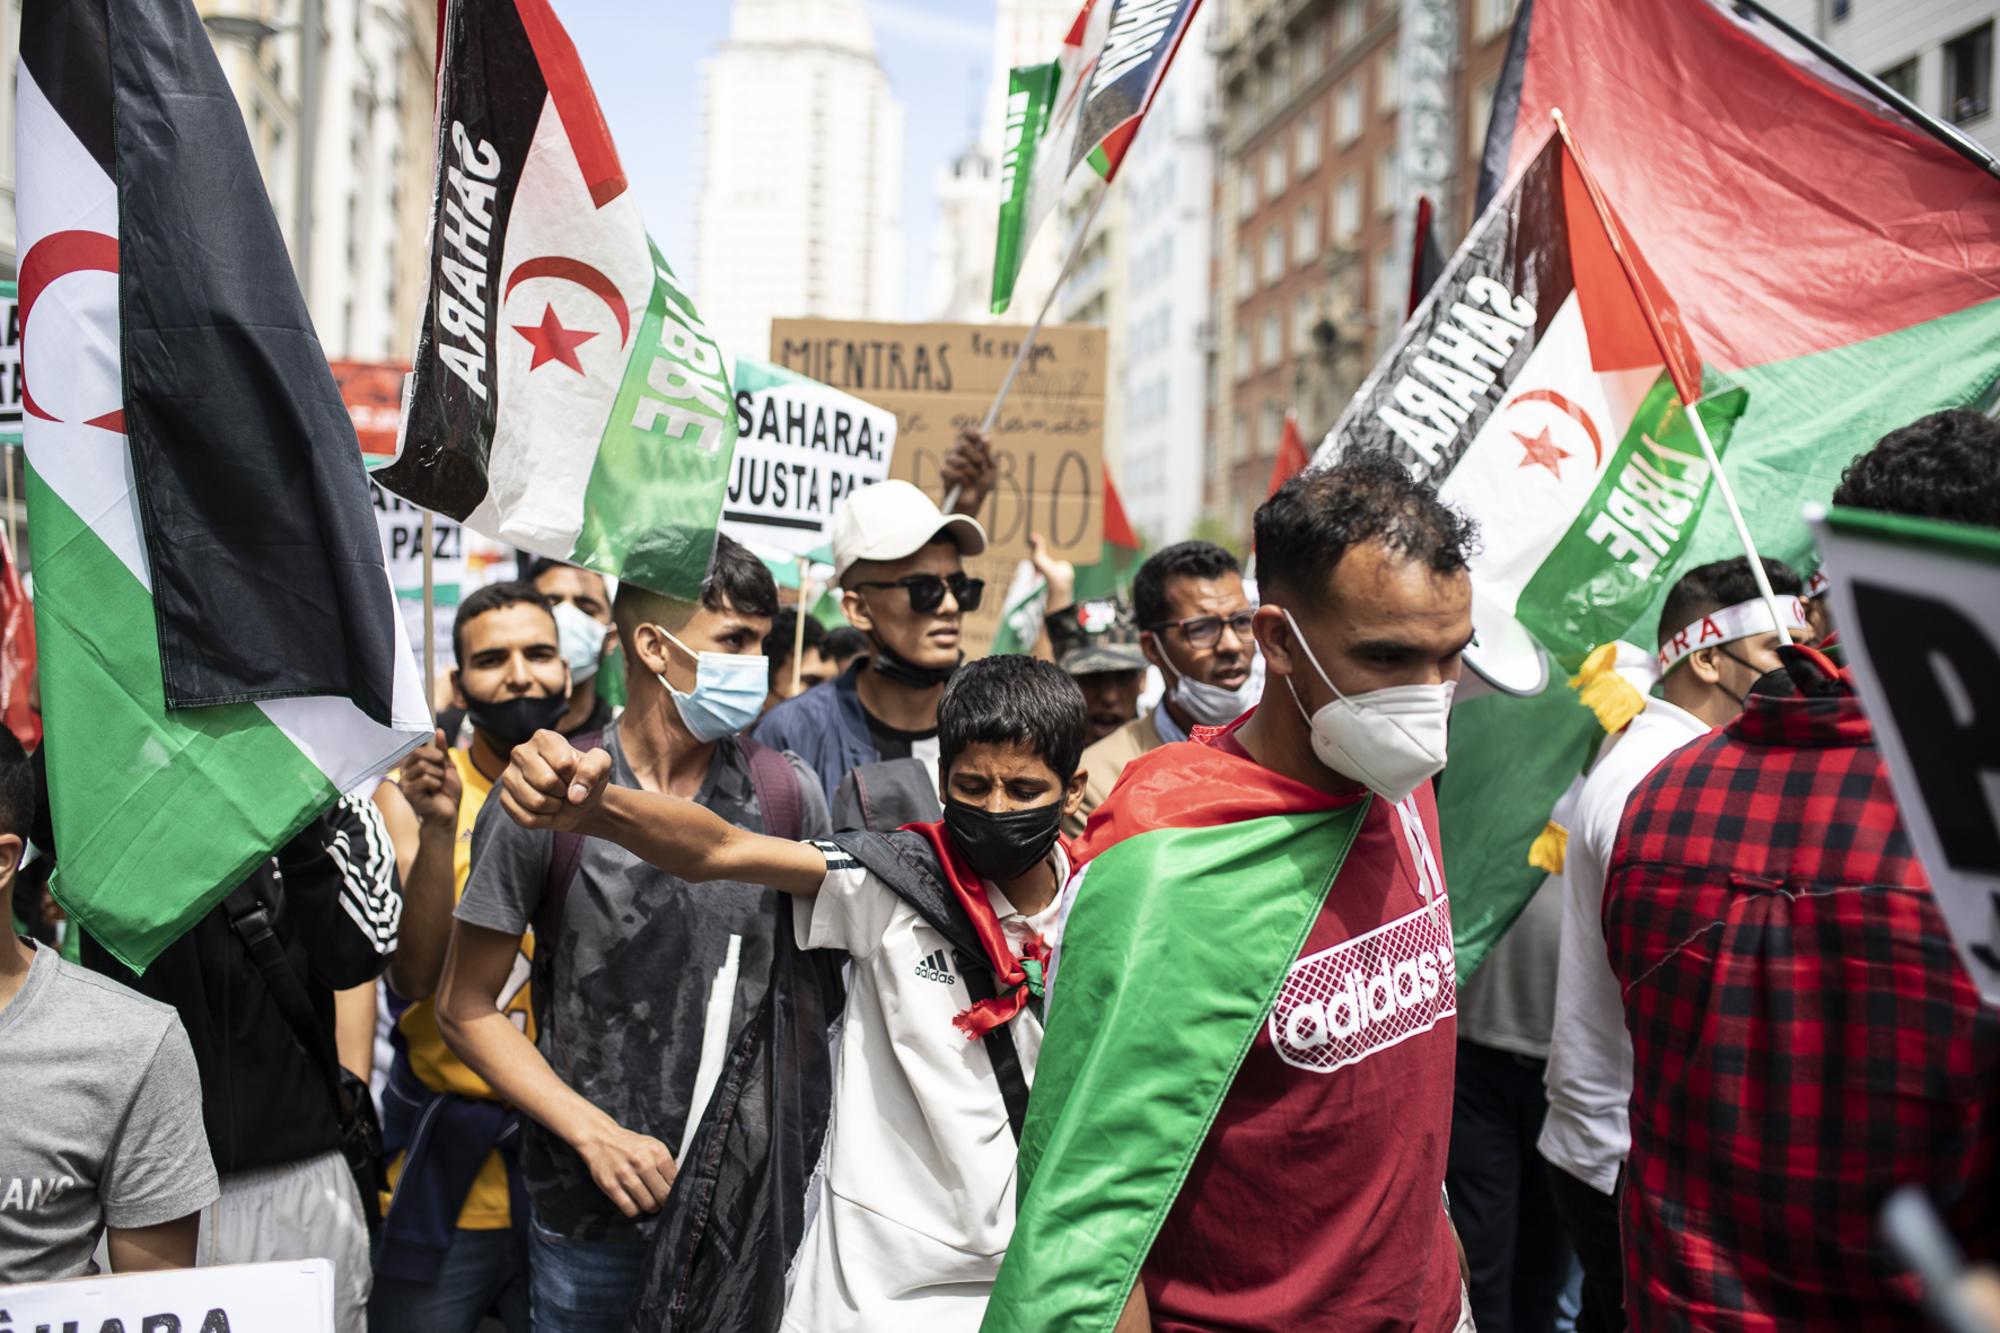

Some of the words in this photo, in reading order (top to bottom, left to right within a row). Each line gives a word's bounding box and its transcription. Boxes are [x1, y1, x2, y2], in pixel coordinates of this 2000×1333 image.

[781, 336, 955, 392] MIENTRAS
[735, 390, 884, 462] SAHARA:
[728, 457, 820, 512] JUSTA
[914, 966, 956, 985] adidas
[1286, 951, 1439, 1050] adidas
